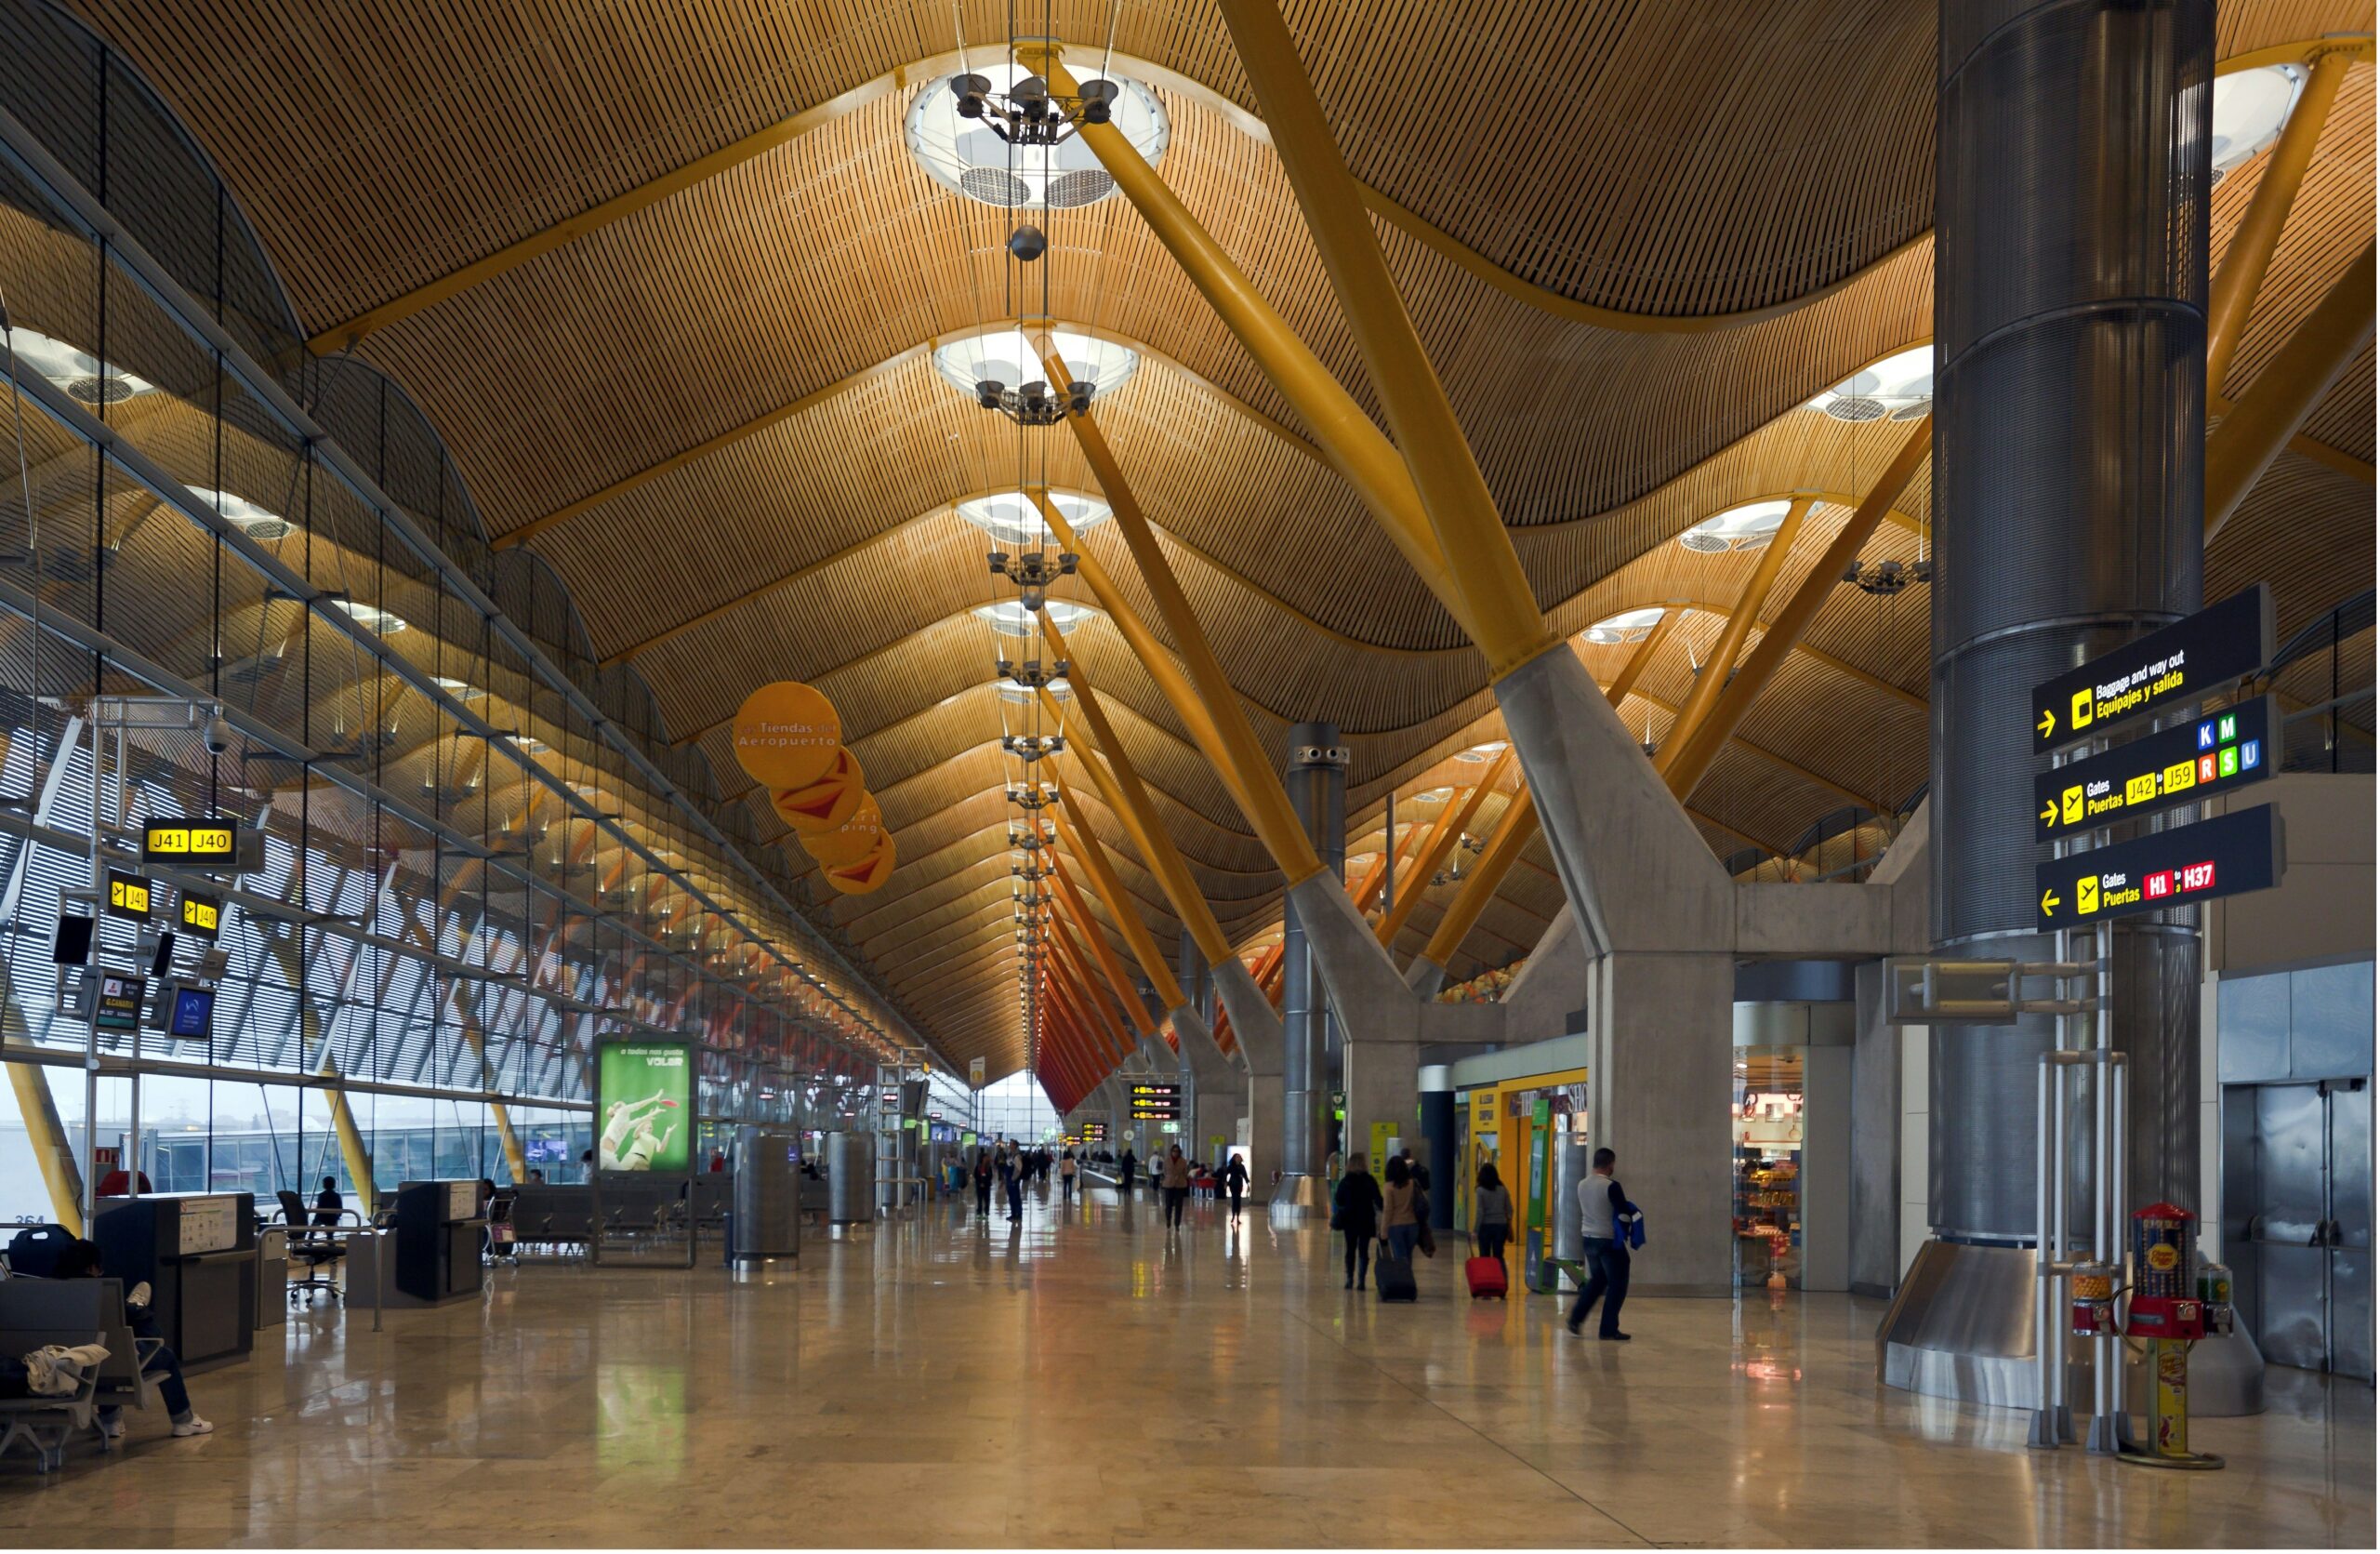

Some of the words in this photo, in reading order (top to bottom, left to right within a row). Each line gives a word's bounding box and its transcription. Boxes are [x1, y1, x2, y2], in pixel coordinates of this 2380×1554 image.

[2096, 675, 2130, 699] Baggage
[2131, 664, 2148, 684] and
[2149, 658, 2167, 677] way
[2168, 649, 2185, 669] out
[2096, 688, 2142, 719] Equipajes
[2144, 684, 2150, 702] y
[2152, 670, 2183, 696] salida
[760, 722, 813, 734] Tiendas
[2200, 724, 2212, 747] K
[2220, 716, 2234, 739] M
[738, 736, 836, 748] Aeropuerto
[2202, 758, 2212, 779] R
[2223, 752, 2234, 773] S
[2244, 743, 2256, 765] U
[2156, 773, 2163, 783] to
[2168, 765, 2191, 788] J59
[2086, 779, 2110, 798] Gates
[2130, 777, 2152, 800] J42
[2157, 785, 2163, 795] a
[2087, 793, 2123, 817] Puertas
[840, 824, 878, 834] ping
[153, 833, 183, 848] J41
[196, 833, 227, 848] J40
[2102, 872, 2126, 889] Gates
[2174, 870, 2182, 881] to
[2184, 864, 2213, 889] H37
[2149, 874, 2167, 897] H1
[2175, 883, 2181, 893] a
[129, 889, 145, 908] J41
[2103, 887, 2140, 908] Puertas
[200, 909, 215, 925] J40
